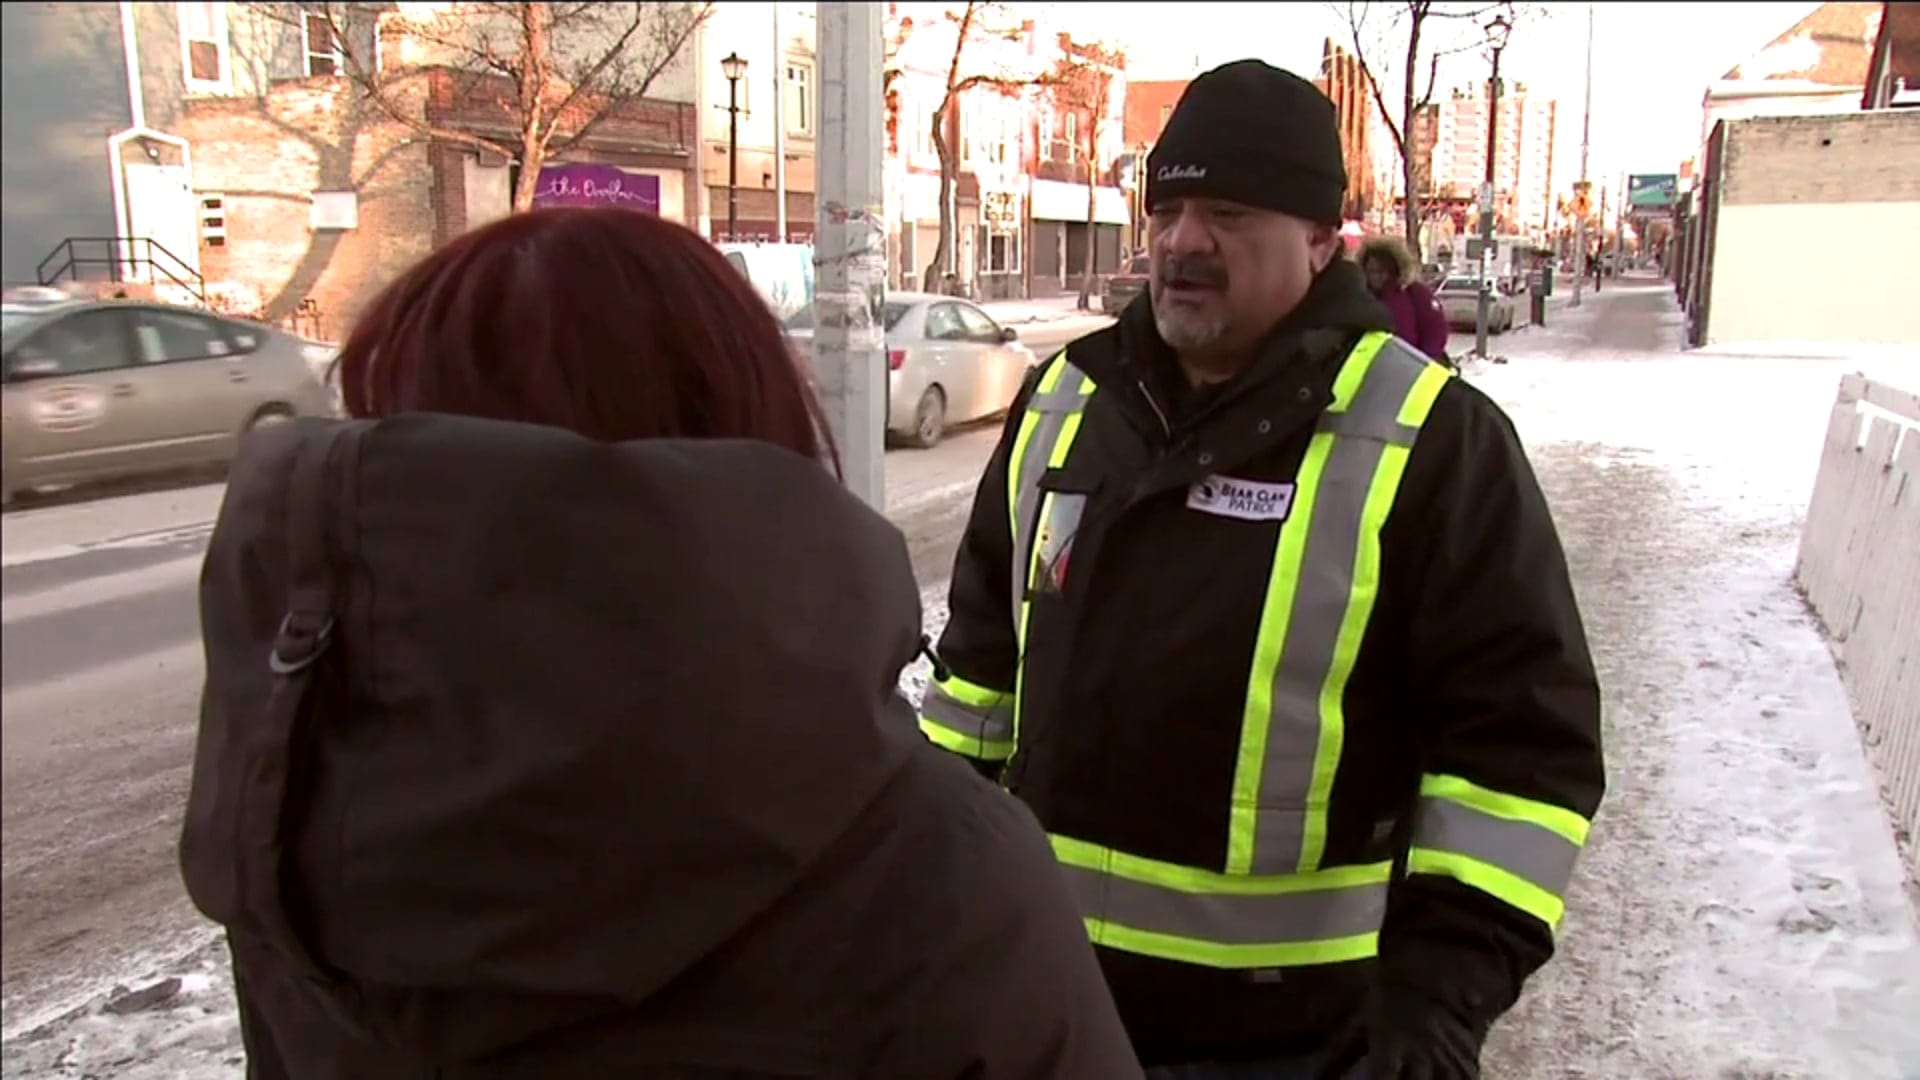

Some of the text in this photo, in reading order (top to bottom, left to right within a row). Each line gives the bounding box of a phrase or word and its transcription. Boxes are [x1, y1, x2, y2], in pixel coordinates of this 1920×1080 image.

[551, 176, 580, 196] the
[1221, 483, 1253, 499] BEAR
[1228, 499, 1275, 514] PATROL
